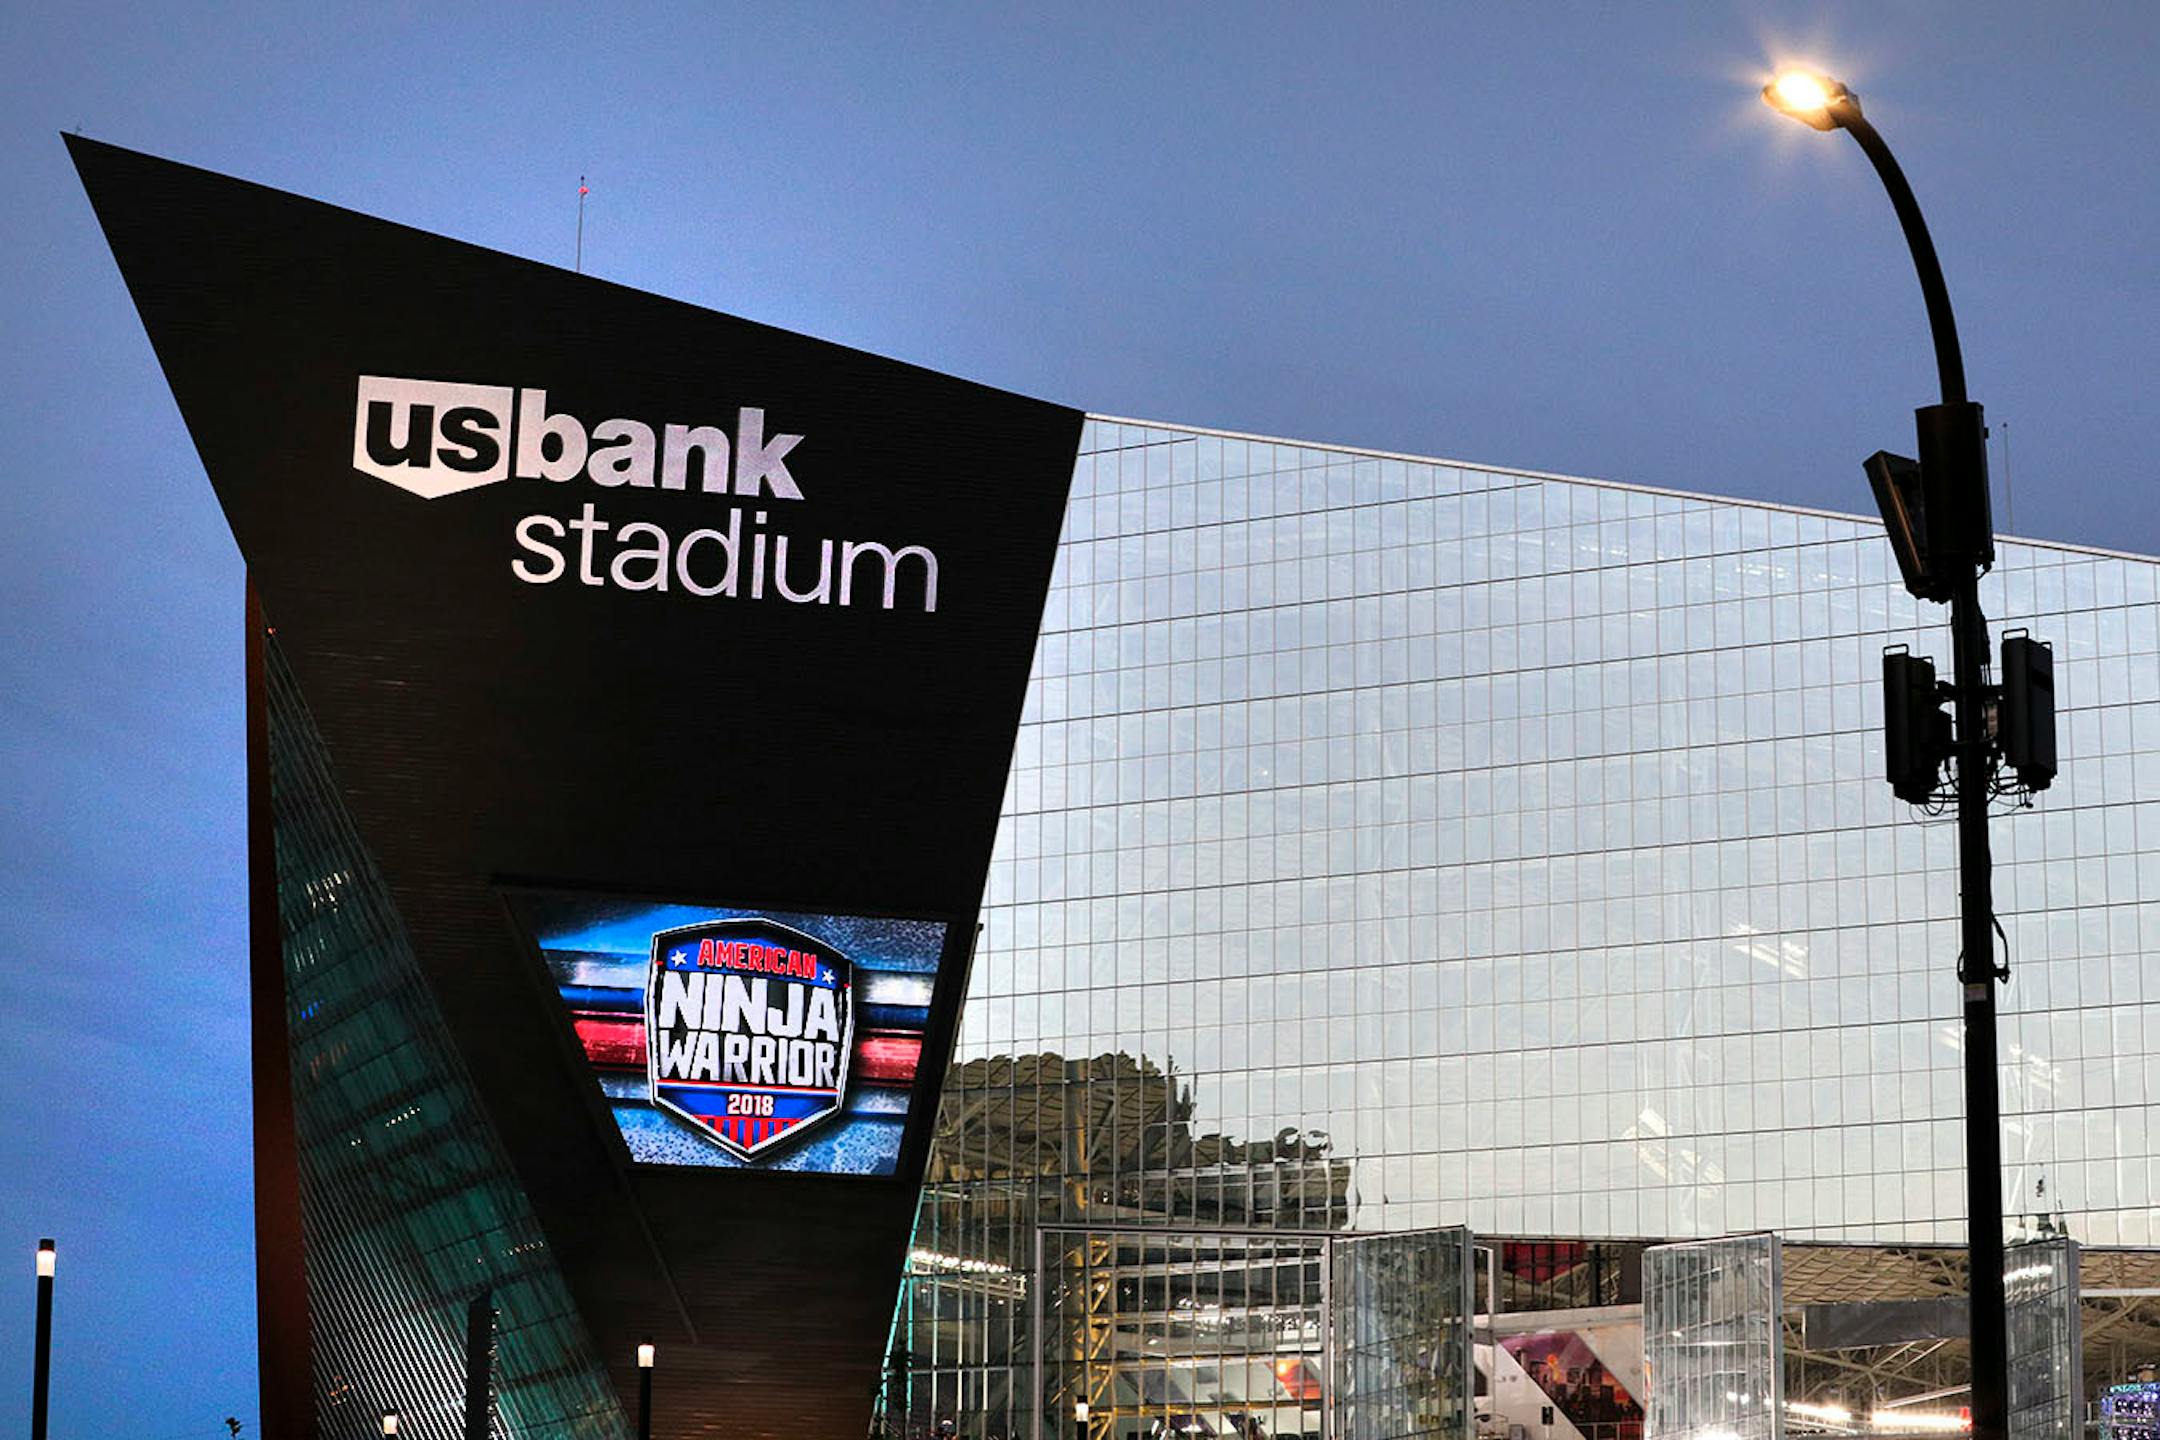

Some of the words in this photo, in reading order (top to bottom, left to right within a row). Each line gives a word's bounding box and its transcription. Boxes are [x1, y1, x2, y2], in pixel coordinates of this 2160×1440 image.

[511, 503, 938, 612] stadium
[697, 939, 817, 979] AMERICAN
[659, 972, 840, 1041] NINJA
[659, 1029, 837, 1087] WARRIOR
[728, 1094, 774, 1116] 2018
